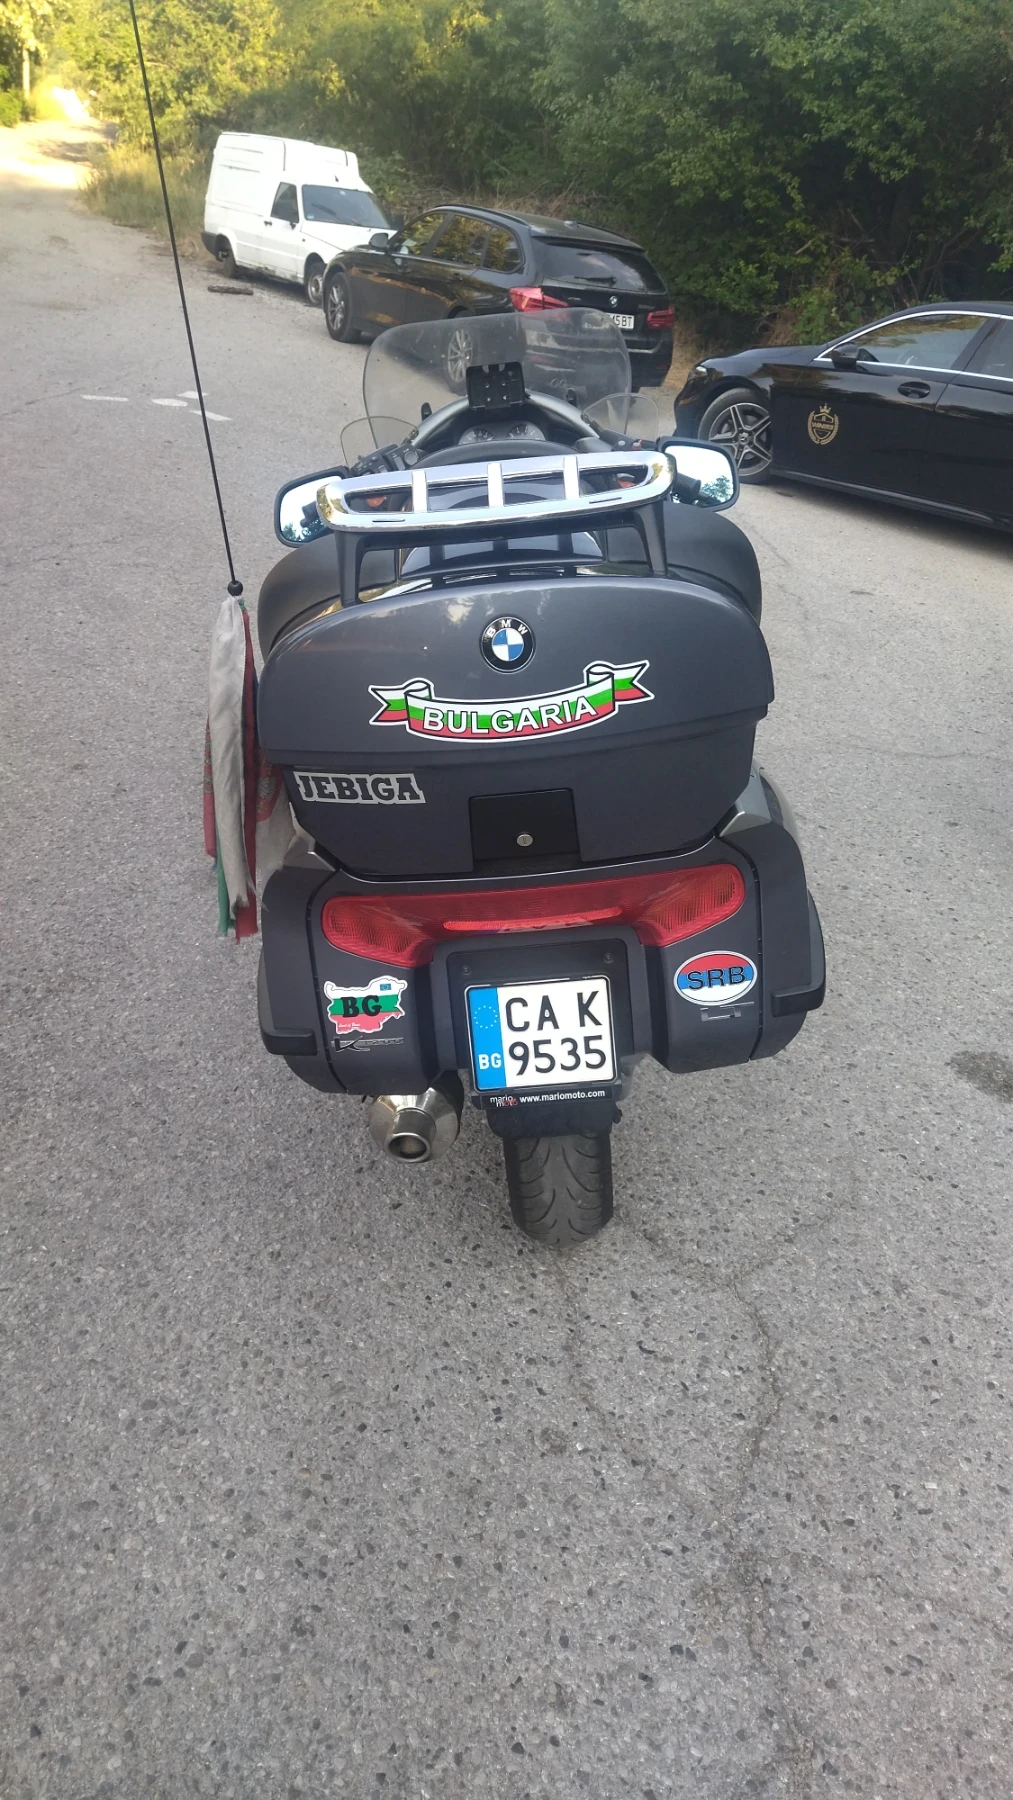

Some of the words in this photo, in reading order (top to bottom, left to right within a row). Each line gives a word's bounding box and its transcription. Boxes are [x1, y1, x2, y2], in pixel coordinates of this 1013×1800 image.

[485, 619, 528, 638] BMW
[422, 696, 598, 734] BULGARIA
[297, 774, 422, 802] JEBIGA
[687, 966, 746, 990] SRB
[340, 995, 383, 1017] BG
[505, 995, 560, 1032] CA
[577, 990, 603, 1028] K
[478, 1053, 501, 1070] BG
[508, 1035, 606, 1076] 9535
[490, 1094, 513, 1103] mario
[519, 1090, 606, 1103] www.mariomoto.com
